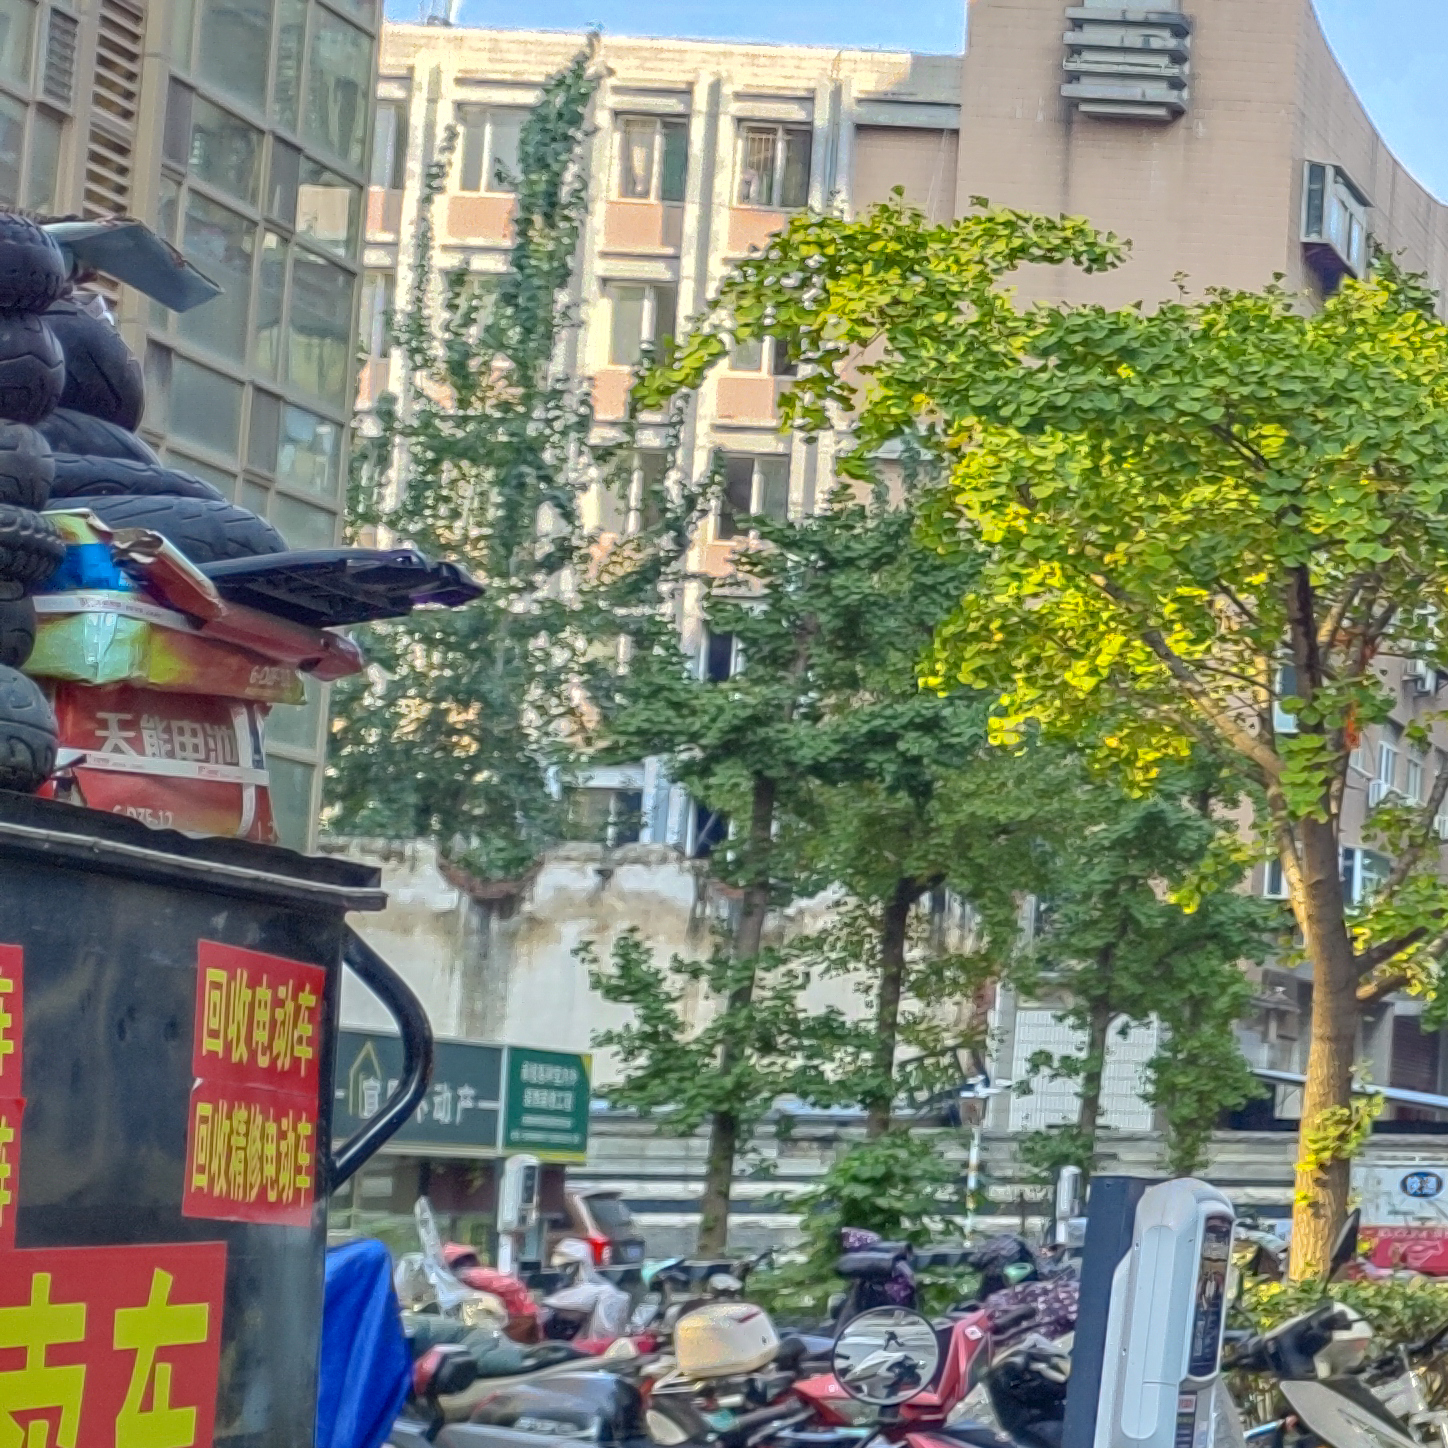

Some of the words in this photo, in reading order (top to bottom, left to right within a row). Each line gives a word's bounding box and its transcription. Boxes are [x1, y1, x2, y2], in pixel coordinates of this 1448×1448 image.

[203, 967, 317, 1077] 回收电动车
[190, 1100, 313, 1208] 回收精修电动车
[359, 1077, 476, 1126] 宜动产
